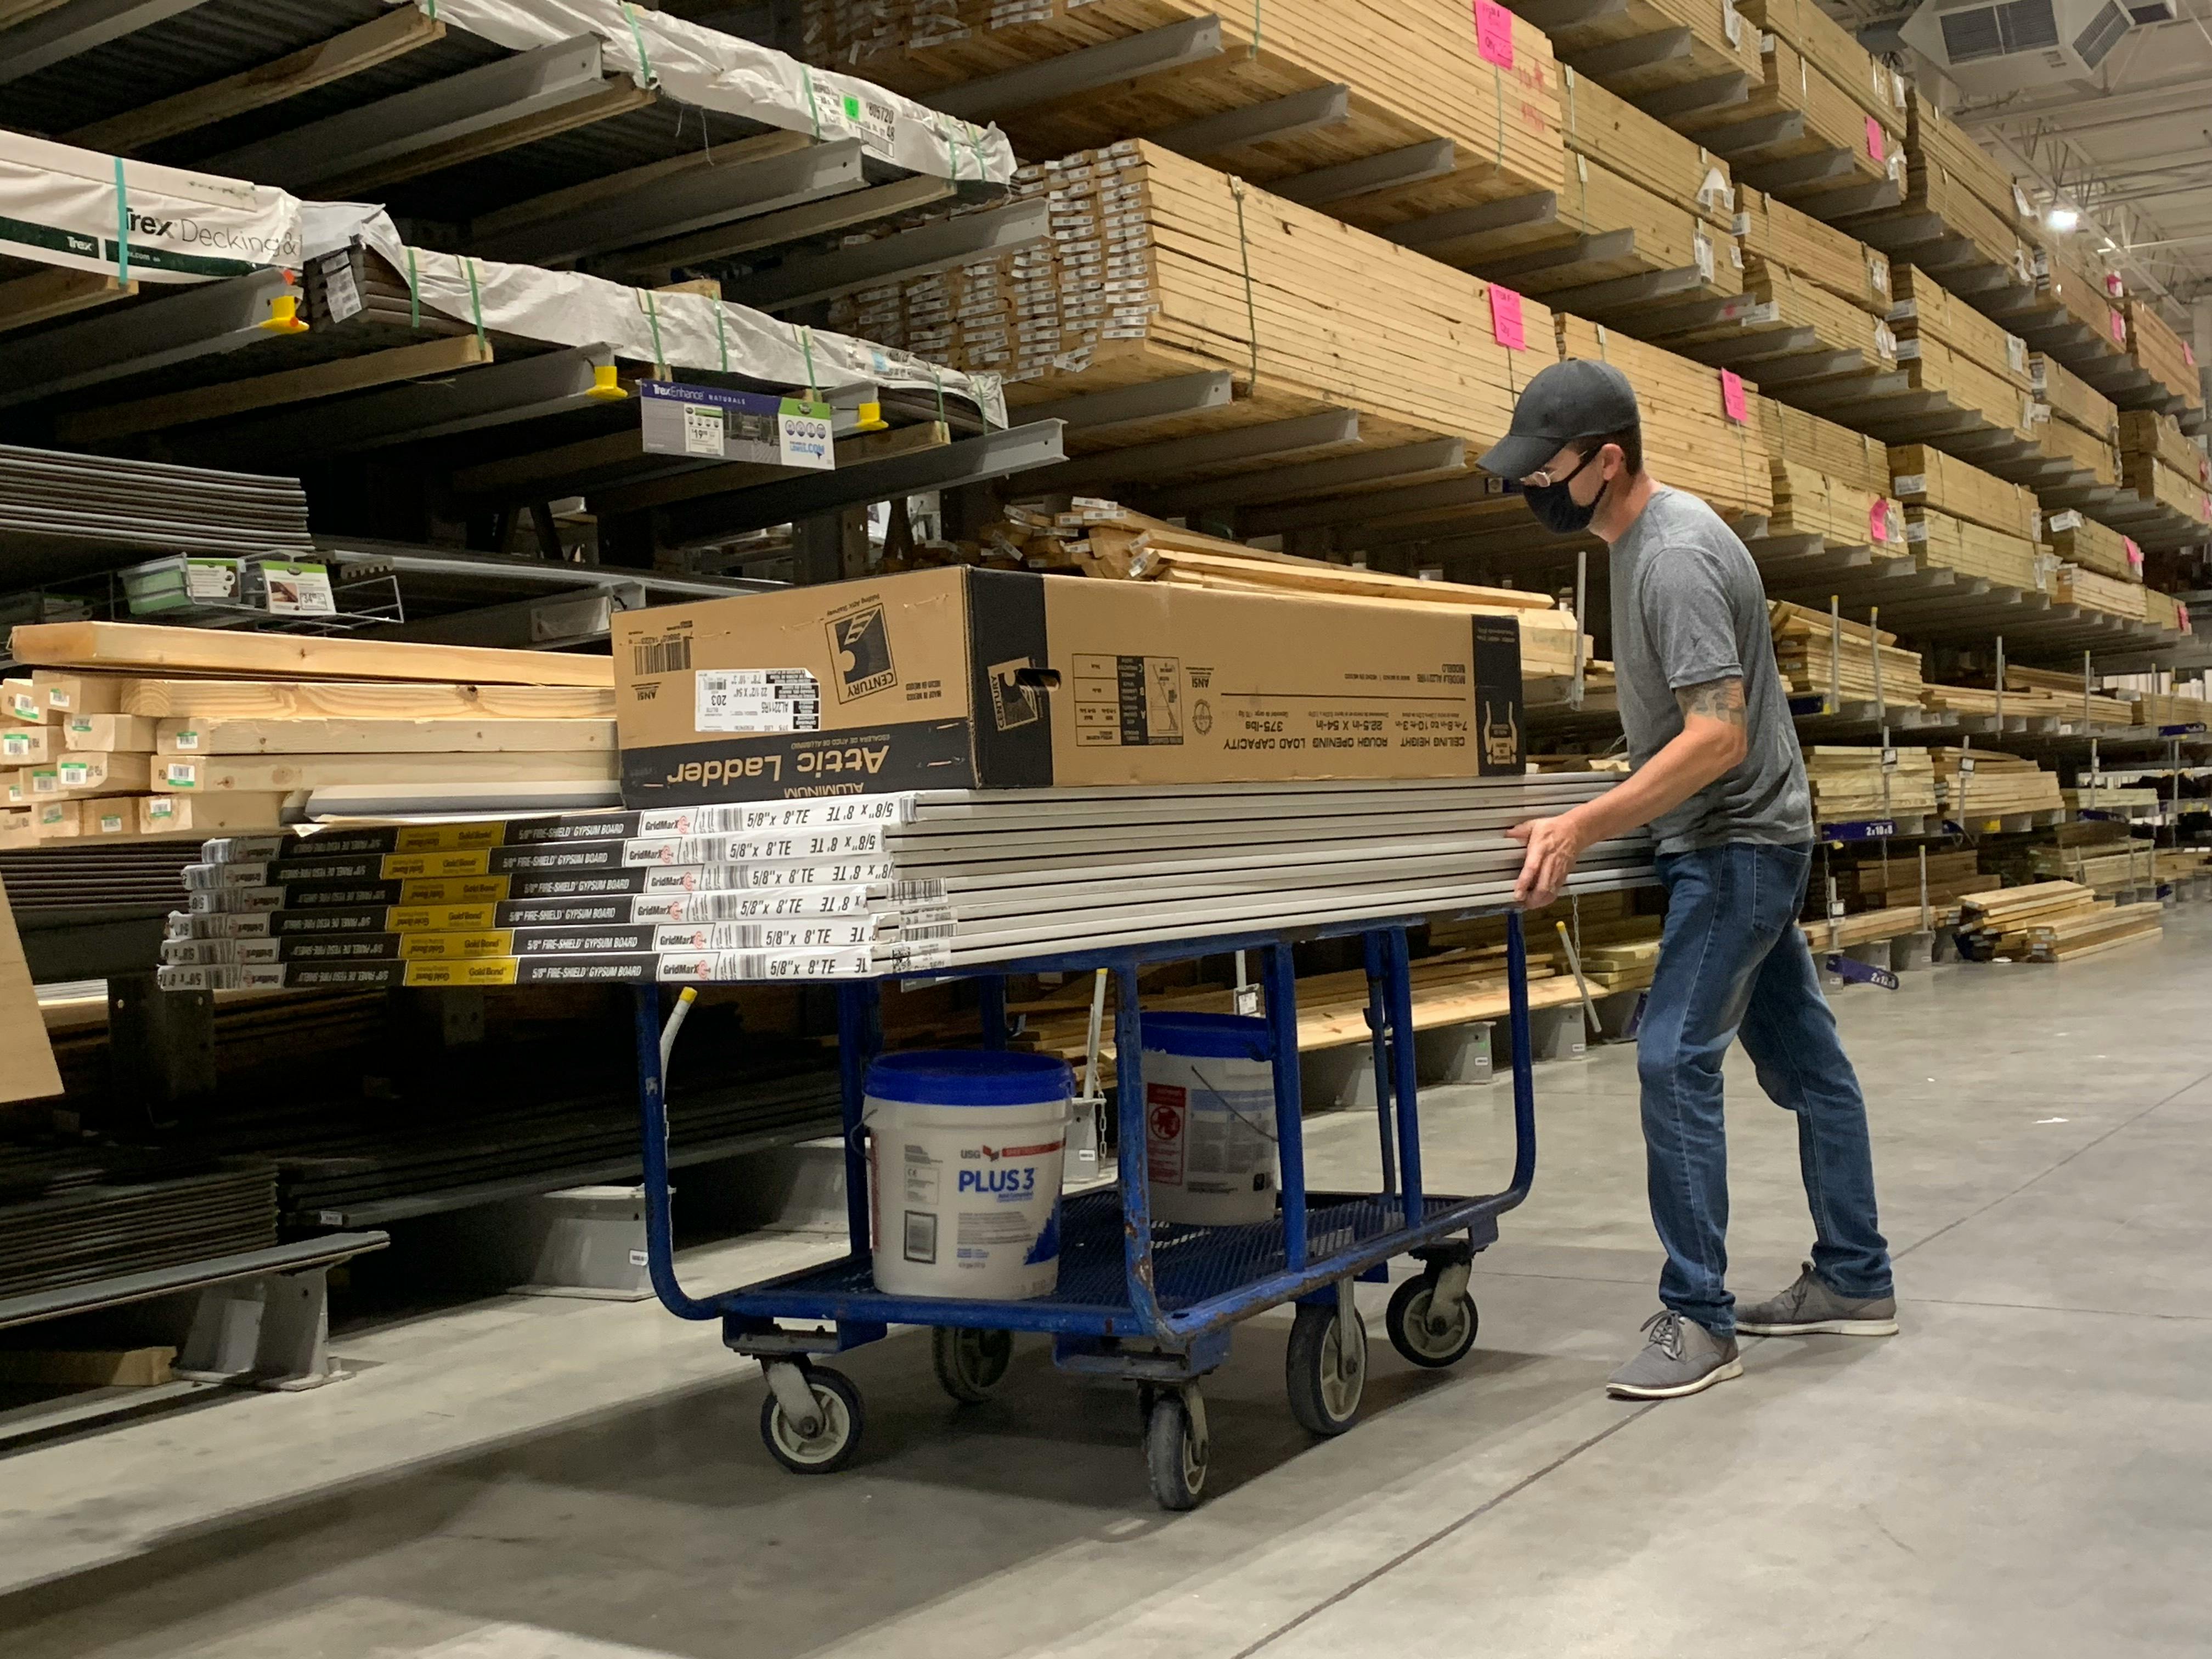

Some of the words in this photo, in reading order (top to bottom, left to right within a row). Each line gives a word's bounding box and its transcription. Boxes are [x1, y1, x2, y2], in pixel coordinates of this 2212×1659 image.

[67, 235, 92, 251] Trex
[180, 218, 281, 256] Decking
[283, 233, 297, 255] &
[708, 394, 746, 405] NATURALS
[847, 672, 894, 697] CENTURY
[712, 695, 726, 706] 203
[991, 675, 1005, 729] CENTURY
[1245, 721, 1283, 732] 375-lbs
[1316, 720, 1339, 731] 54-in
[1343, 720, 1349, 731] X
[860, 733, 890, 743] ESCALERA
[1223, 738, 1276, 750] CAPACITY
[1279, 738, 1305, 749] LOAD
[1312, 737, 1354, 748] OPENING
[1357, 737, 1387, 747] ROUGH
[1400, 737, 1430, 747] HEIGHT
[1433, 737, 1465, 747] CEILING
[797, 746, 890, 778] Attic
[667, 754, 782, 787] Ladder
[783, 782, 865, 798] ALUMINUM
[827, 806, 840, 822] TE
[810, 839, 823, 854] TE
[558, 854, 585, 865] GYPSUM
[585, 853, 608, 864] BOARD
[832, 866, 846, 881] TE
[819, 897, 835, 912] TE
[566, 909, 592, 919] GYPSUM
[593, 907, 615, 918] BOARD
[850, 927, 864, 943] TE
[584, 938, 612, 949] GYPSUM
[614, 936, 637, 947] BOARD
[854, 957, 868, 973] TE
[589, 966, 617, 977] GYPSUM
[618, 966, 642, 977] BOARD
[961, 1149, 981, 1159] USG
[958, 1169, 1020, 1193] PLUS
[1023, 1167, 1035, 1190] 3
